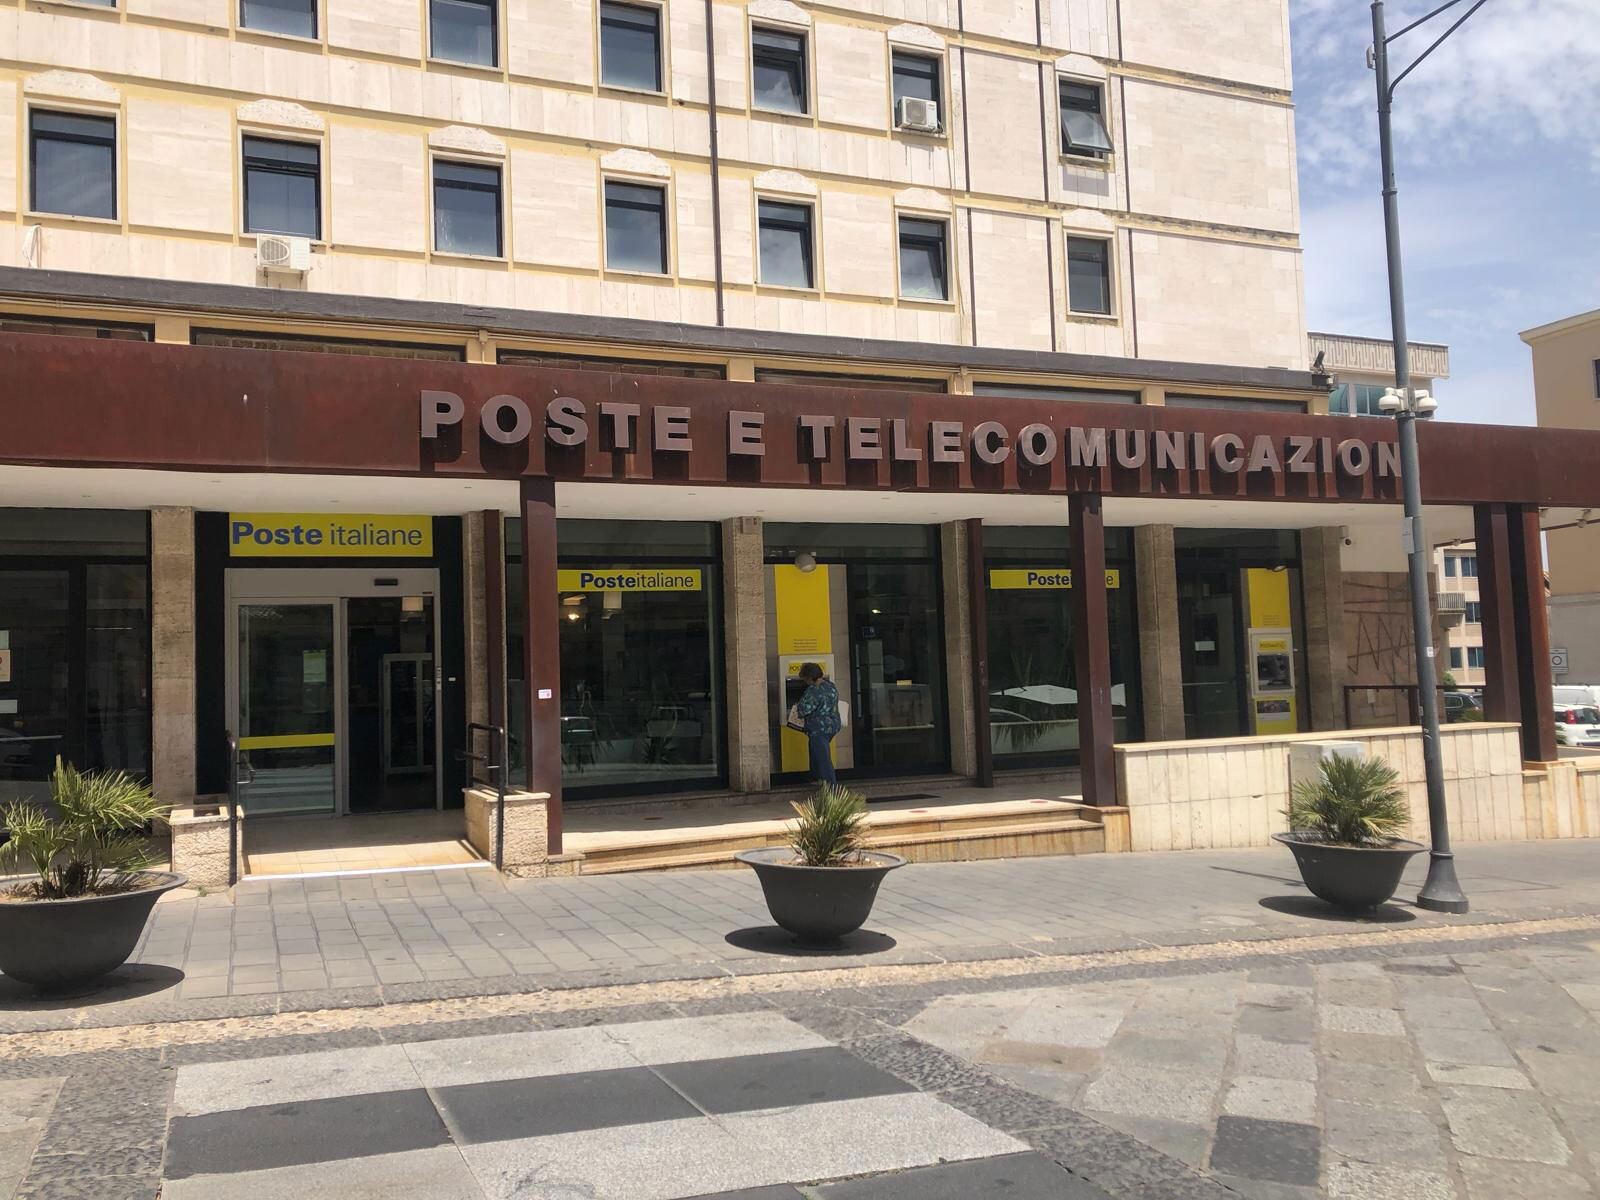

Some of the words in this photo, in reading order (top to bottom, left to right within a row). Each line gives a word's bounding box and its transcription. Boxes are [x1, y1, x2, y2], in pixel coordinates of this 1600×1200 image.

[420, 389, 693, 452] POSTE
[729, 410, 766, 456] E
[799, 414, 1421, 478] TELECOMUNICAZION
[232, 521, 323, 546] Poste
[329, 523, 423, 546] italiane
